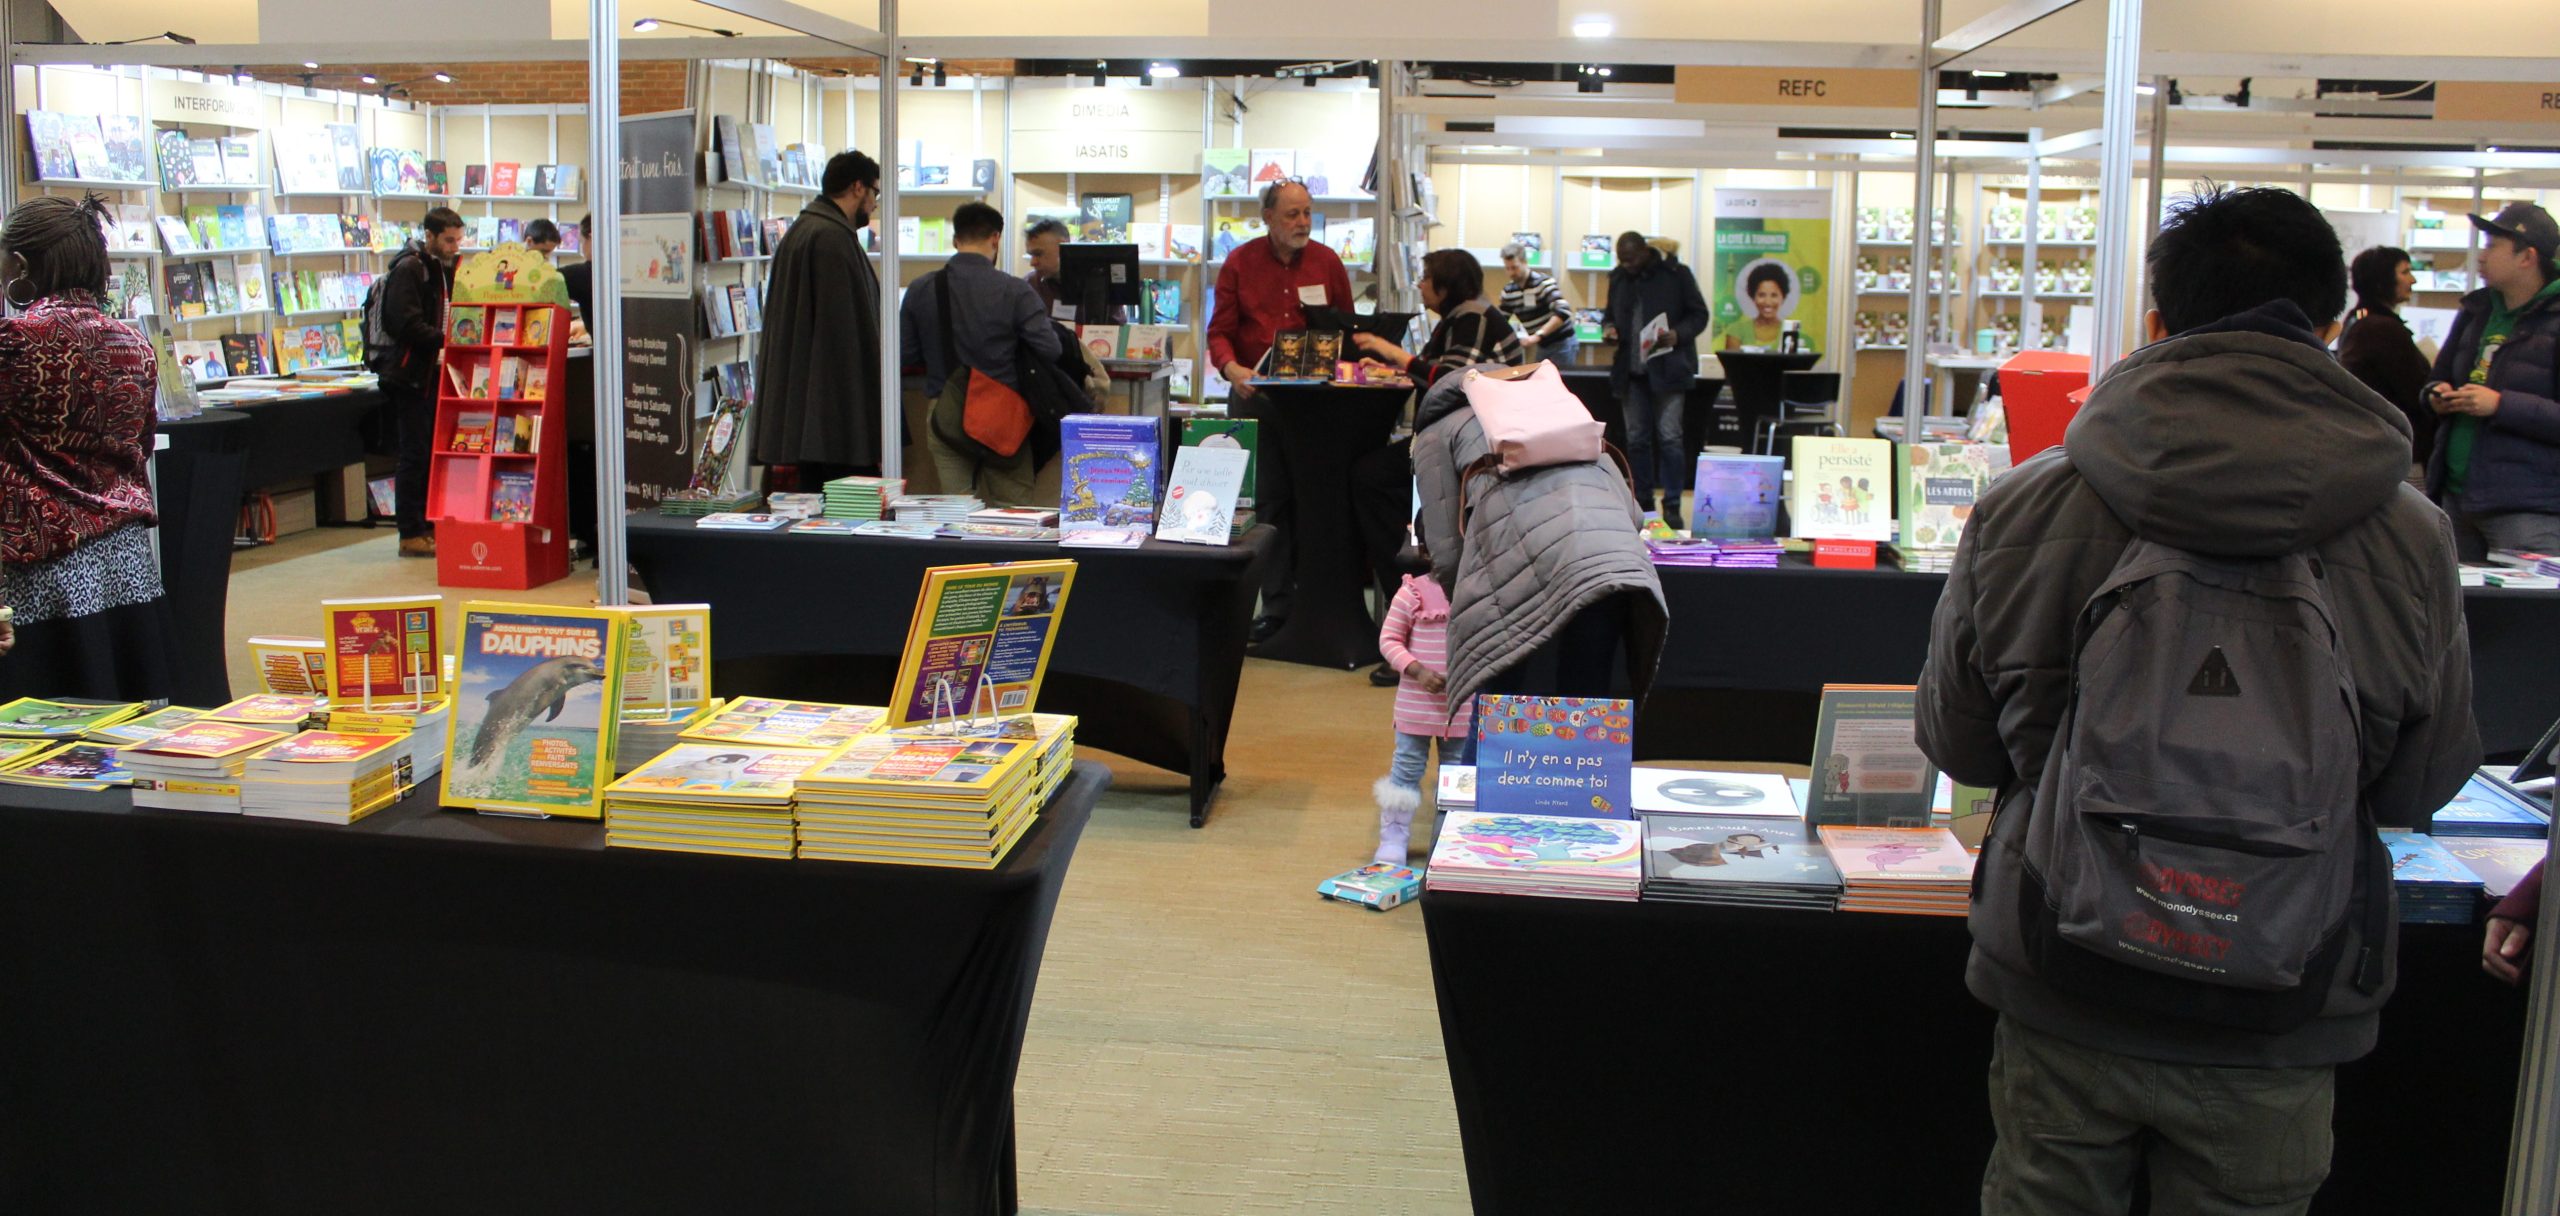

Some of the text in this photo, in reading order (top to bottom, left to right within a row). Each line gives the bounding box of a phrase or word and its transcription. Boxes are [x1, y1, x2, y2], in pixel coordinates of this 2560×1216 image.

[1779, 80, 1826, 96] REFC
[1072, 104, 1129, 117] DIMEDIA
[1075, 145, 1128, 158] IASATIS
[1819, 453, 1873, 470] persisté
[493, 624, 542, 635] ABSOLUMENT
[545, 627, 565, 636] TOUT
[483, 632, 601, 658] DAUPHINS
[1503, 749, 1603, 771] Il n'y en a pas
[1497, 771, 1608, 789] deux comme toi
